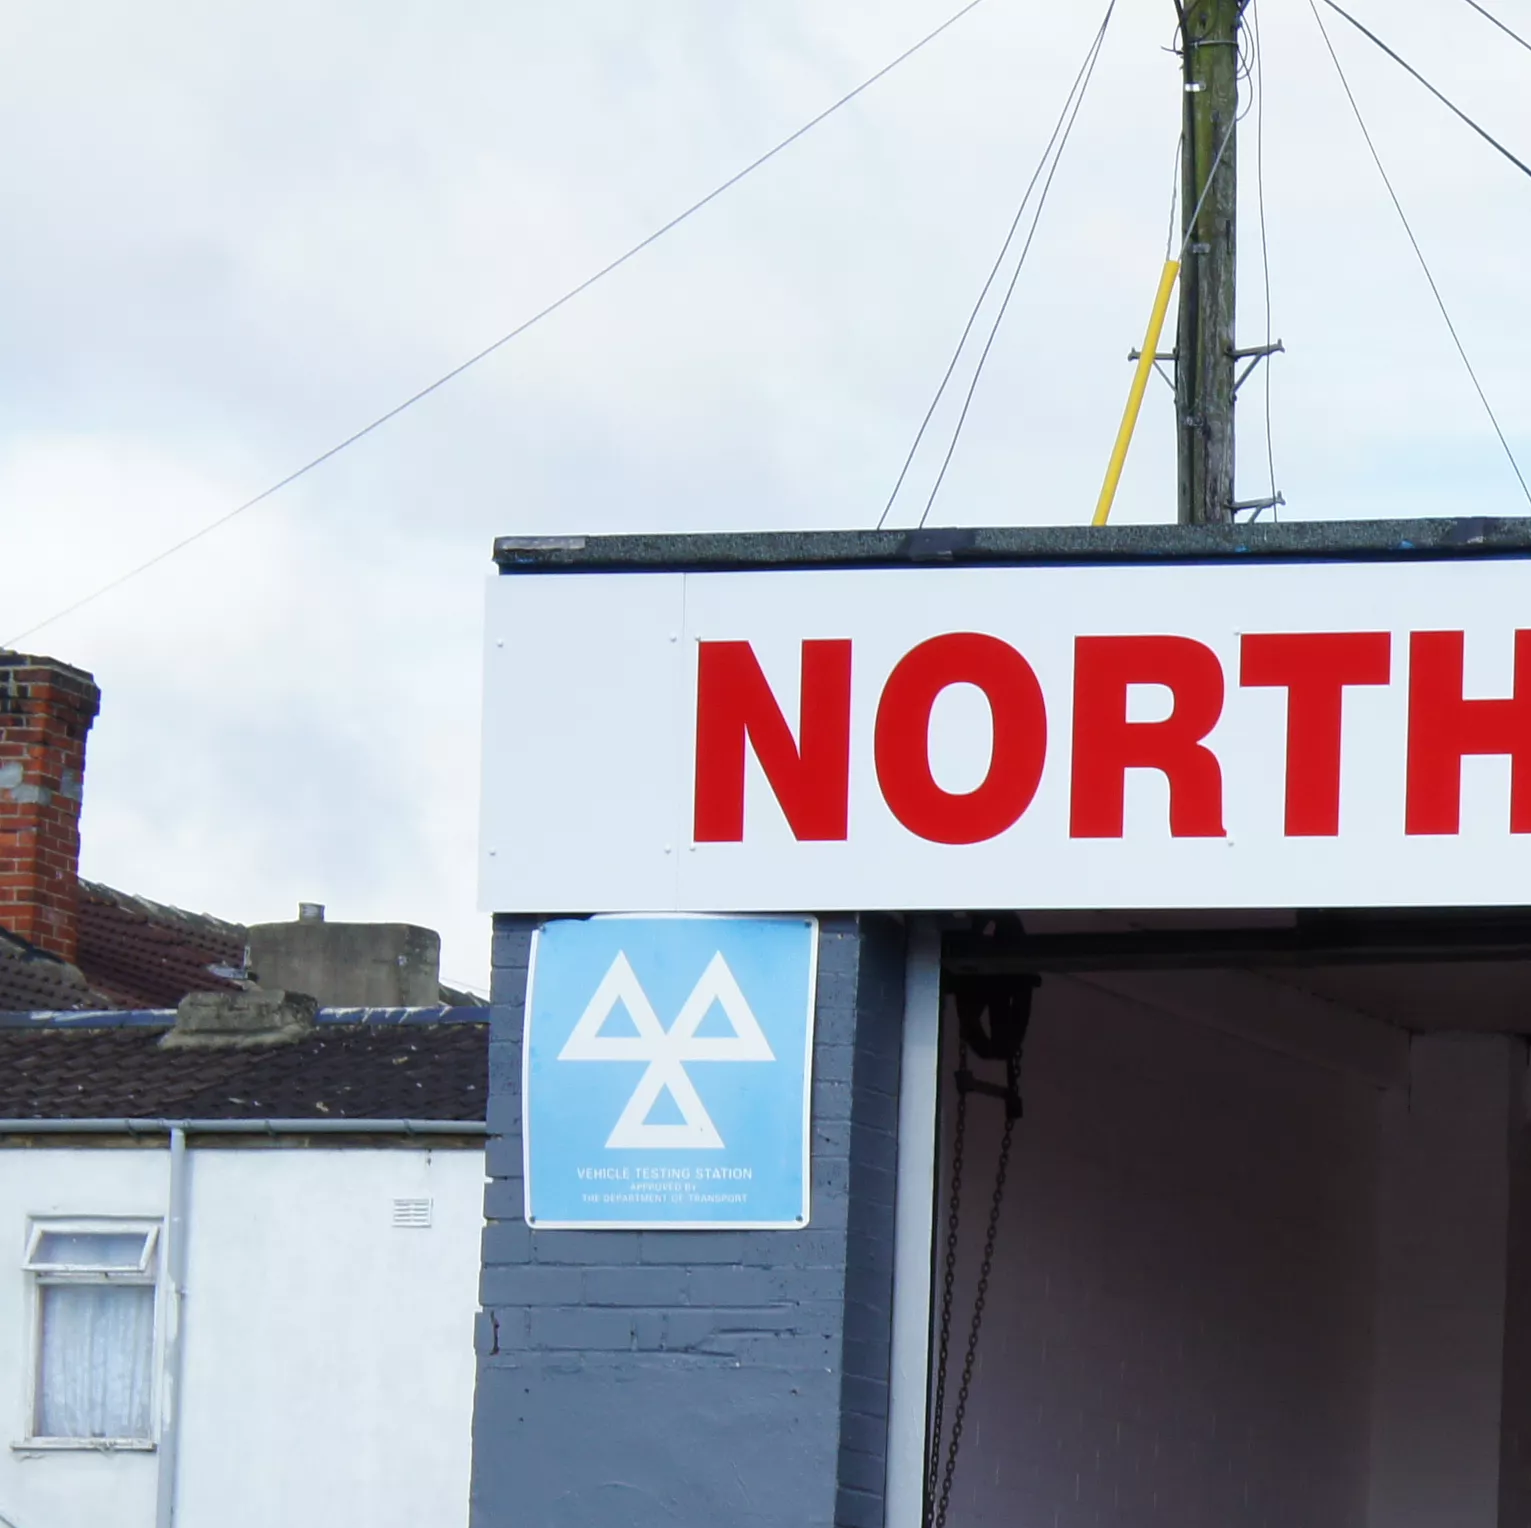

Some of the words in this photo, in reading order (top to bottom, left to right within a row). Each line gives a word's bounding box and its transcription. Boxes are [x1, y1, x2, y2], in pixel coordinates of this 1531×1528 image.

[577, 1167, 630, 1180] VEHICLE
[636, 1167, 690, 1180] TESTING
[695, 1167, 752, 1180] STATION
[603, 1193, 667, 1204] DEPARTMENT
[689, 1193, 748, 1204] TRANSPORT
